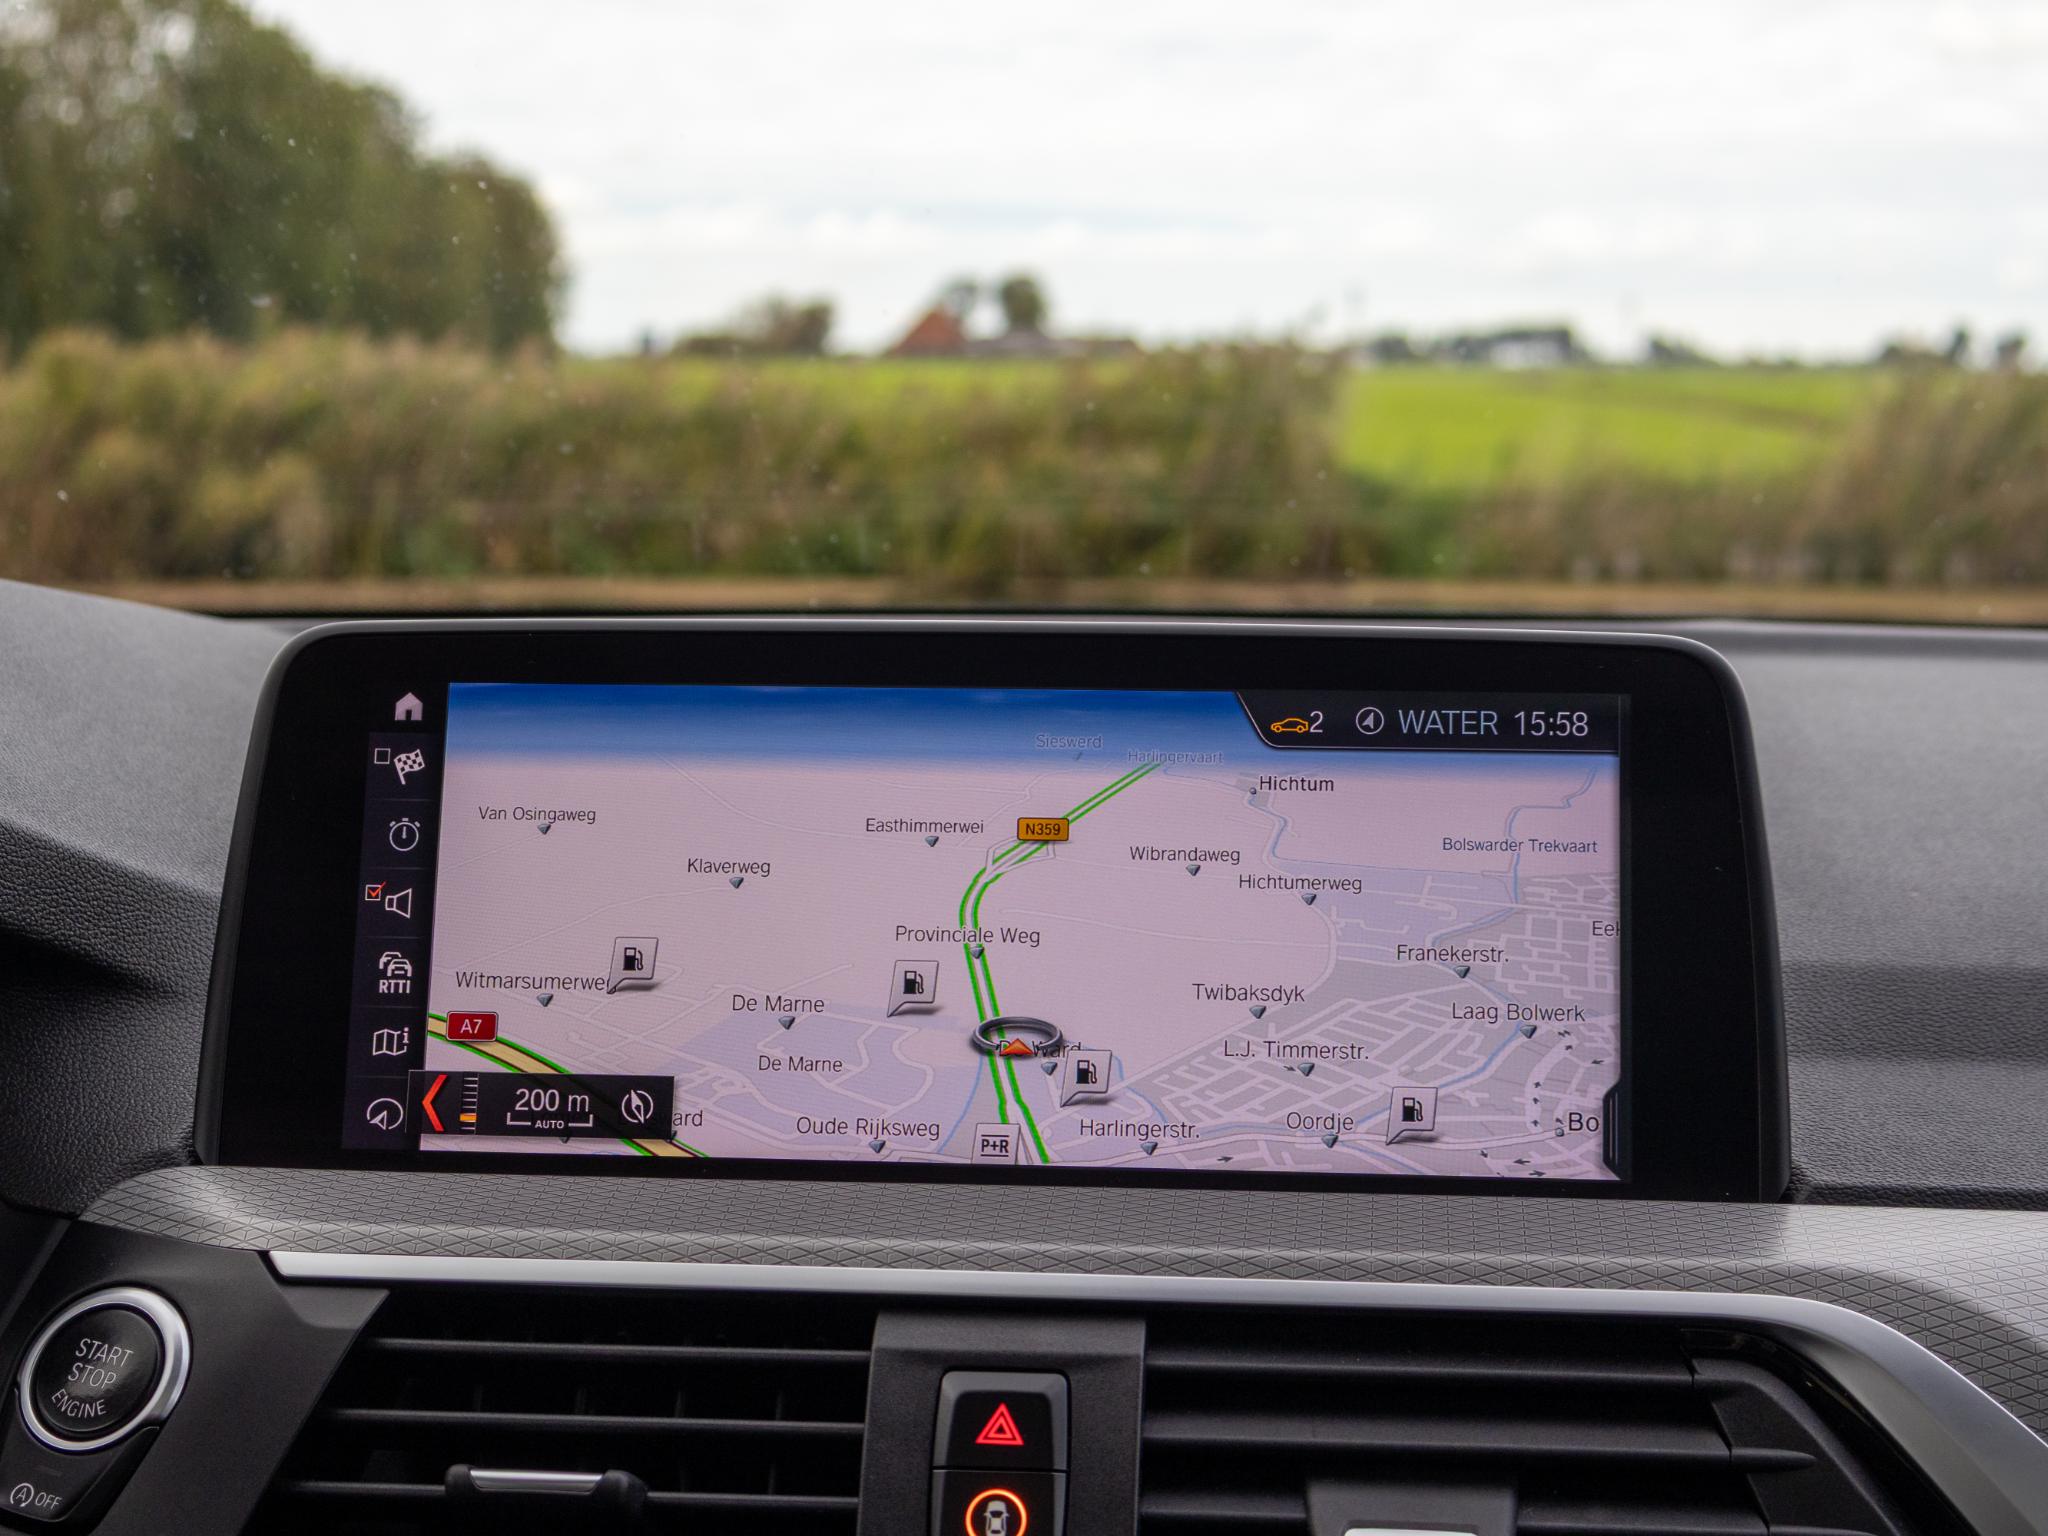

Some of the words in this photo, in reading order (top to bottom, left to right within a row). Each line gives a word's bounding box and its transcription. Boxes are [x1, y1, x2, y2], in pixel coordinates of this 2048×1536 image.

[1309, 712, 1324, 732] 2
[1398, 710, 1499, 736] WATER
[1513, 711, 1589, 737] 15:58
[1035, 734, 1102, 750] Sieswerd
[1128, 750, 1223, 765] Harlingervaart
[1259, 776, 1334, 792] Hichtum
[478, 806, 507, 821] Van
[512, 806, 596, 824] Osingaweg
[865, 818, 984, 835] Easthimmerwei
[1024, 822, 1061, 837] N359
[1129, 845, 1241, 865] Wibrandaweg
[1442, 837, 1522, 853] Bolswarder
[1528, 838, 1597, 854] Trekvaart
[686, 858, 771, 878] Klaverweg
[1238, 873, 1362, 895] Hichtumerweg
[895, 925, 994, 944] Provinciale
[1000, 926, 1041, 947] Weg
[1396, 945, 1509, 964] Franekerstr.
[378, 979, 411, 994] RTTI
[455, 971, 610, 991] Witmarsumerwe
[1192, 983, 1305, 1004] Twibaksdyk
[732, 995, 758, 1011] De
[765, 996, 825, 1013] Marne
[1452, 1003, 1498, 1024] Laag
[1506, 1003, 1585, 1023] Bolwerk
[460, 1018, 482, 1034] A7
[1224, 1040, 1256, 1058] L.J.
[1263, 1041, 1369, 1060] Timmerstr.
[758, 1055, 784, 1071] De
[788, 1056, 843, 1073] Marne
[514, 1088, 559, 1112] 200
[567, 1093, 589, 1112] m
[534, 1119, 565, 1130] AUTO
[796, 1116, 848, 1135] Oude
[856, 1117, 940, 1140] Rijksweg
[1079, 1118, 1201, 1140] Harlingerstr.
[1286, 1111, 1354, 1133] Oordje
[981, 1138, 1010, 1154] P+R
[75, 1338, 134, 1367] START
[68, 1362, 117, 1389] STOP
[51, 1388, 107, 1419] ENGINE
[35, 1491, 63, 1510] OFF
